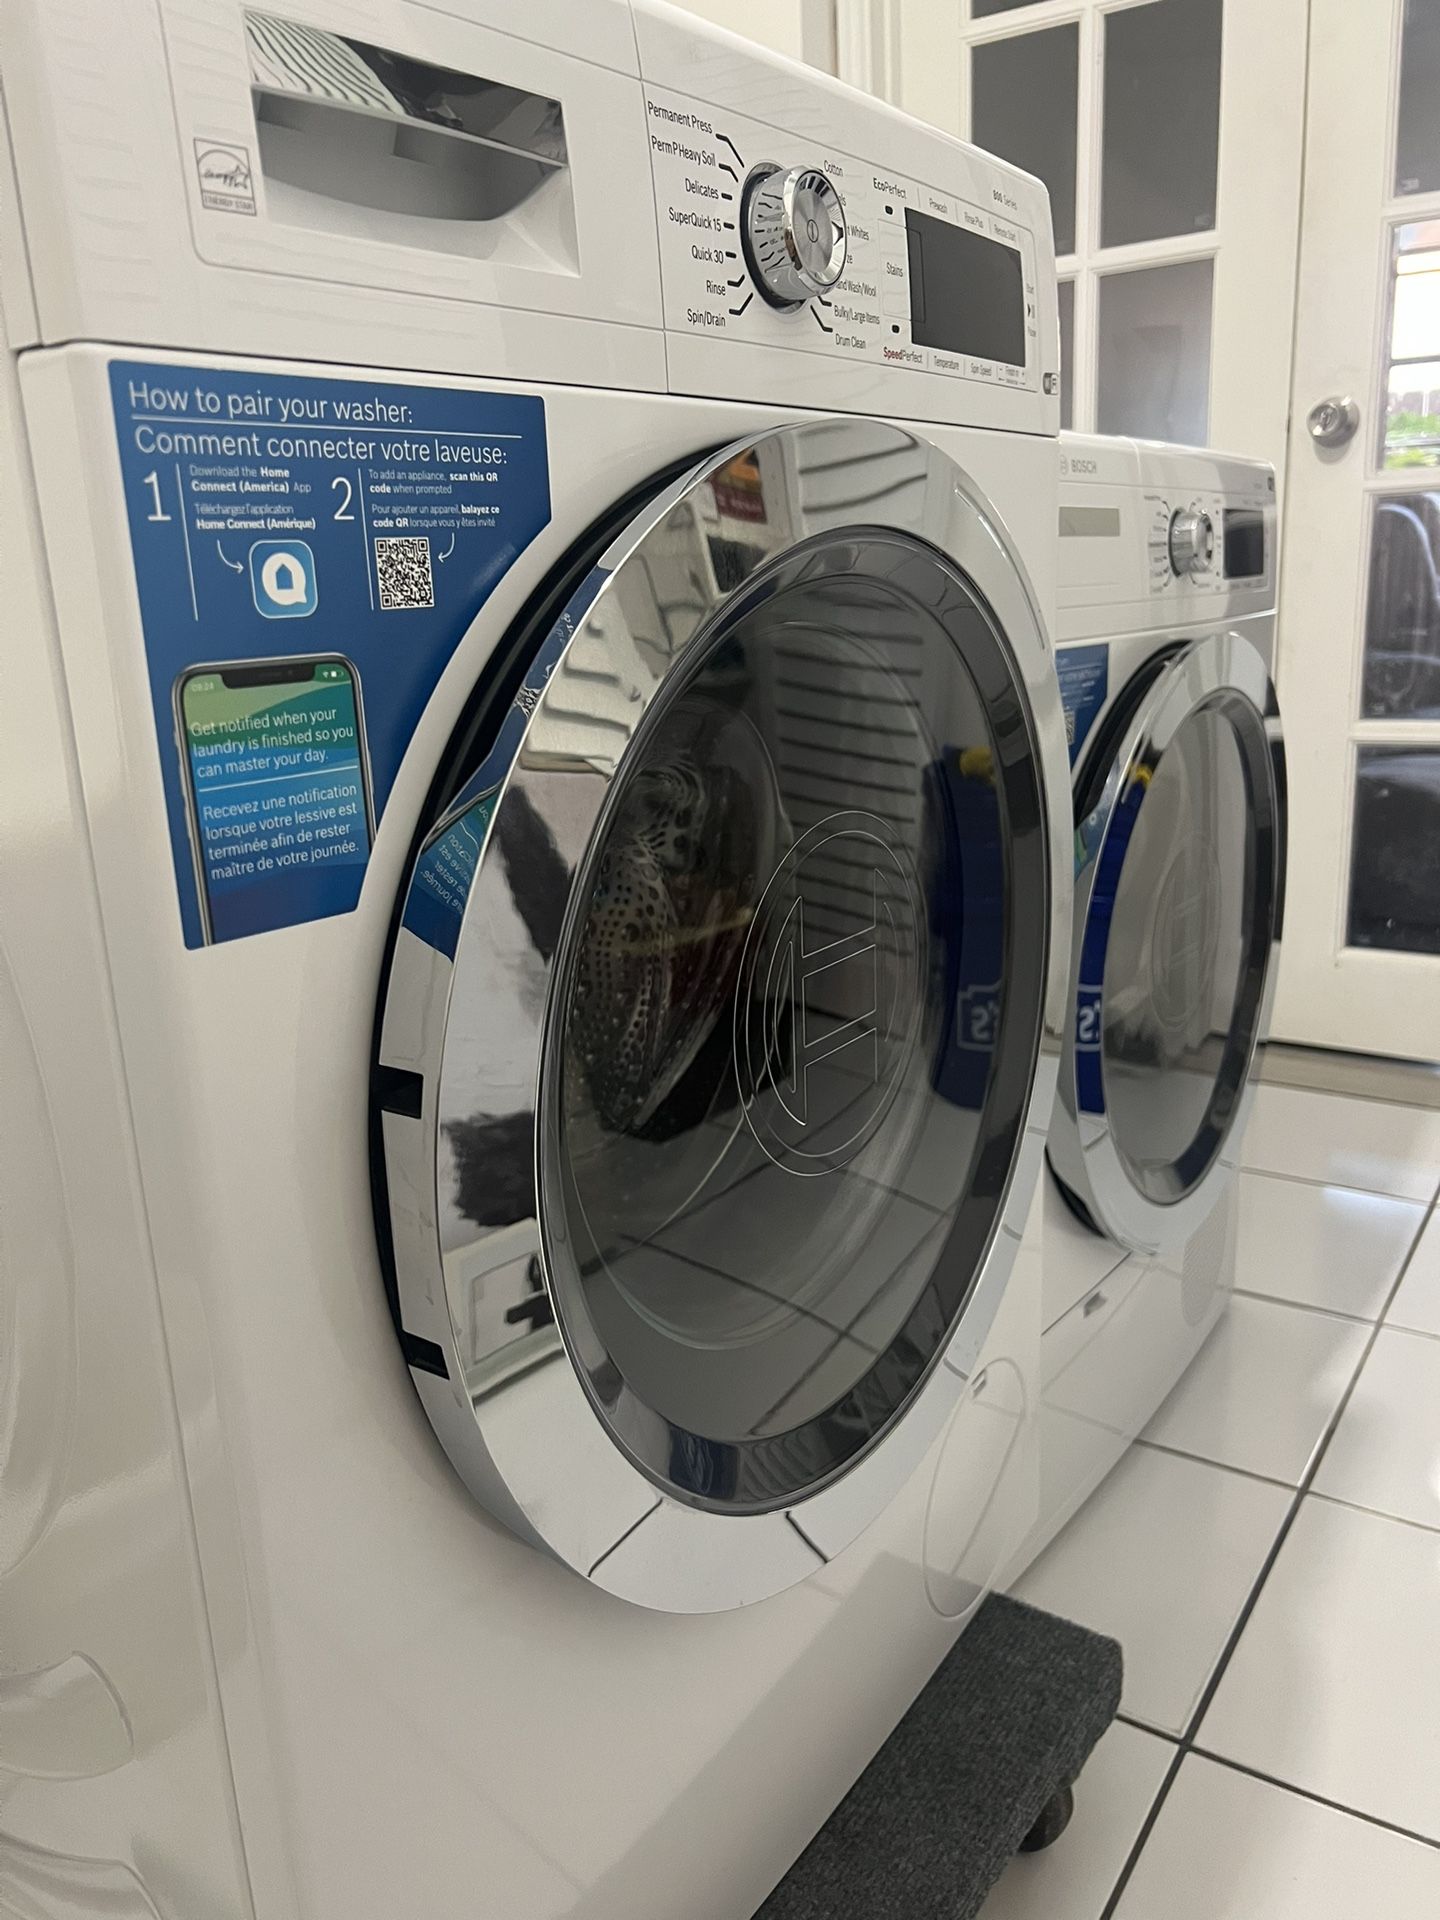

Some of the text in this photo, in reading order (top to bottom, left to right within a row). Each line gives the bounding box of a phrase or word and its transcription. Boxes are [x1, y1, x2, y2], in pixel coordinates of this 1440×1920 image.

[648, 100, 713, 134] Permanent Press
[651, 135, 673, 155] Perm
[679, 144, 701, 166] Heavy
[702, 150, 716, 167] Soil
[824, 160, 844, 177] Cotton
[685, 178, 719, 200] Delicates
[873, 177, 907, 199] EcoPerfect
[669, 207, 722, 232] SuperQuick 15
[851, 225, 869, 241] Whites
[692, 245, 724, 264] Quick 30
[886, 262, 903, 277] Stains
[706, 279, 726, 296] Rinse
[848, 281, 877, 297] Wash/Wool
[687, 308, 726, 327] Spin/Drain
[834, 304, 880, 325] Bulky/Large Items
[835, 333, 866, 349] Drum Clean
[883, 346, 922, 363] SpeedPerfect
[129, 380, 413, 424] How to pair your washer:
[135, 425, 507, 464] Comment connecter votre laveuse:
[189, 464, 290, 477] Download the Home
[368, 469, 498, 482] To add an appliance, scan this QR
[1072, 459, 1097, 474] BOSCH
[144, 471, 171, 521] 1
[191, 480, 312, 494] Connect (America) App
[370, 483, 452, 495] code when prompted
[331, 477, 355, 520] 2
[372, 504, 390, 513] Pour
[392, 505, 418, 514] ajouter
[420, 506, 429, 514] un
[461, 504, 489, 516] balayez
[491, 506, 500, 514] ce
[196, 517, 316, 531] Home Connect (Amérique)
[373, 517, 496, 528] code QR lorsque vous y êtes invité
[190, 708, 337, 737] Get notified when your
[194, 727, 354, 758] laundry is finished so you
[197, 749, 328, 778] can master your day.
[203, 784, 357, 821] Recevez une notification
[205, 803, 358, 841] lorsque votre lessive est
[208, 823, 351, 861] terminée afin de rester
[211, 839, 359, 880] maître de votre journée.
